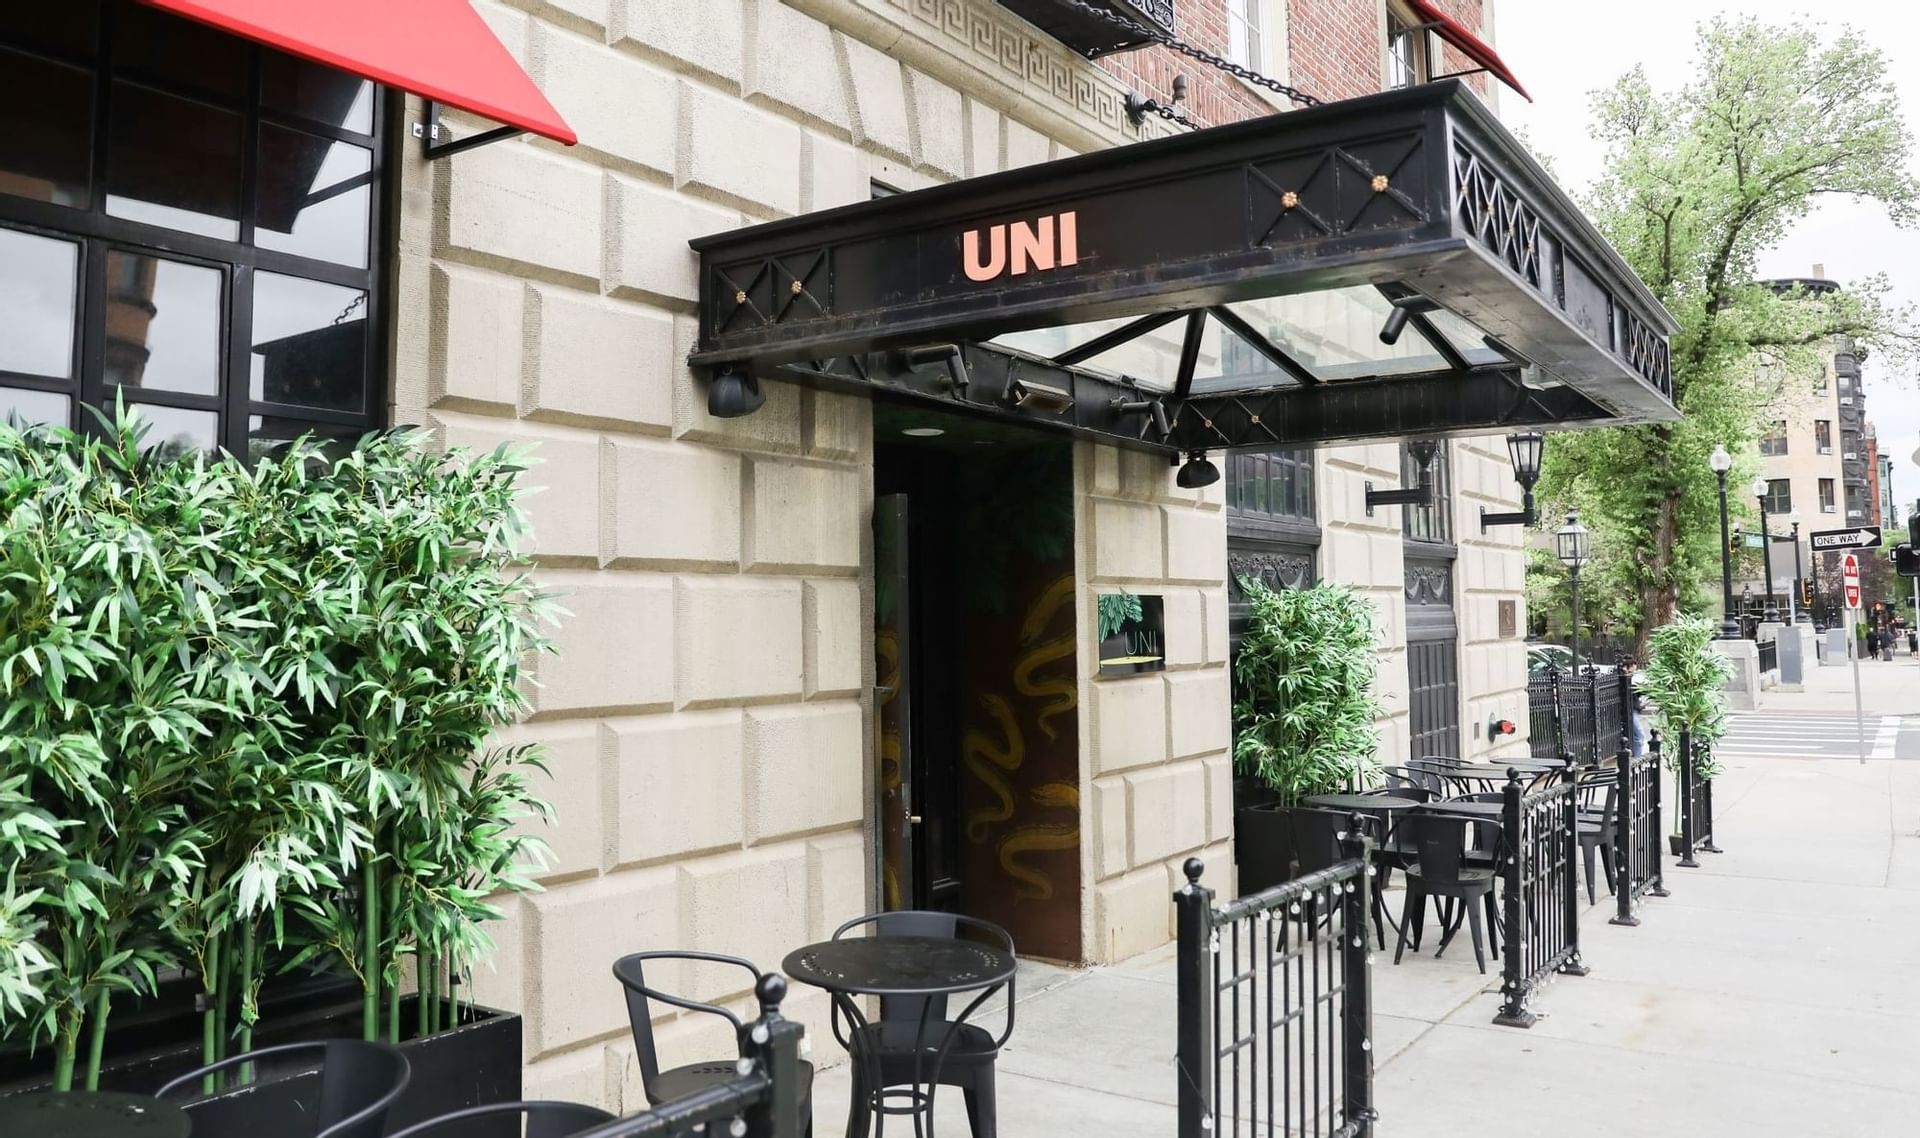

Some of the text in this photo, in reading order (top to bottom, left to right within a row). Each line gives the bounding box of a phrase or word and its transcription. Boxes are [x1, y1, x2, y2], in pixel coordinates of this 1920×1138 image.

[963, 211, 1077, 282] UNI
[1816, 534, 1860, 546] ONE WAY
[1124, 631, 1157, 655] UNI
